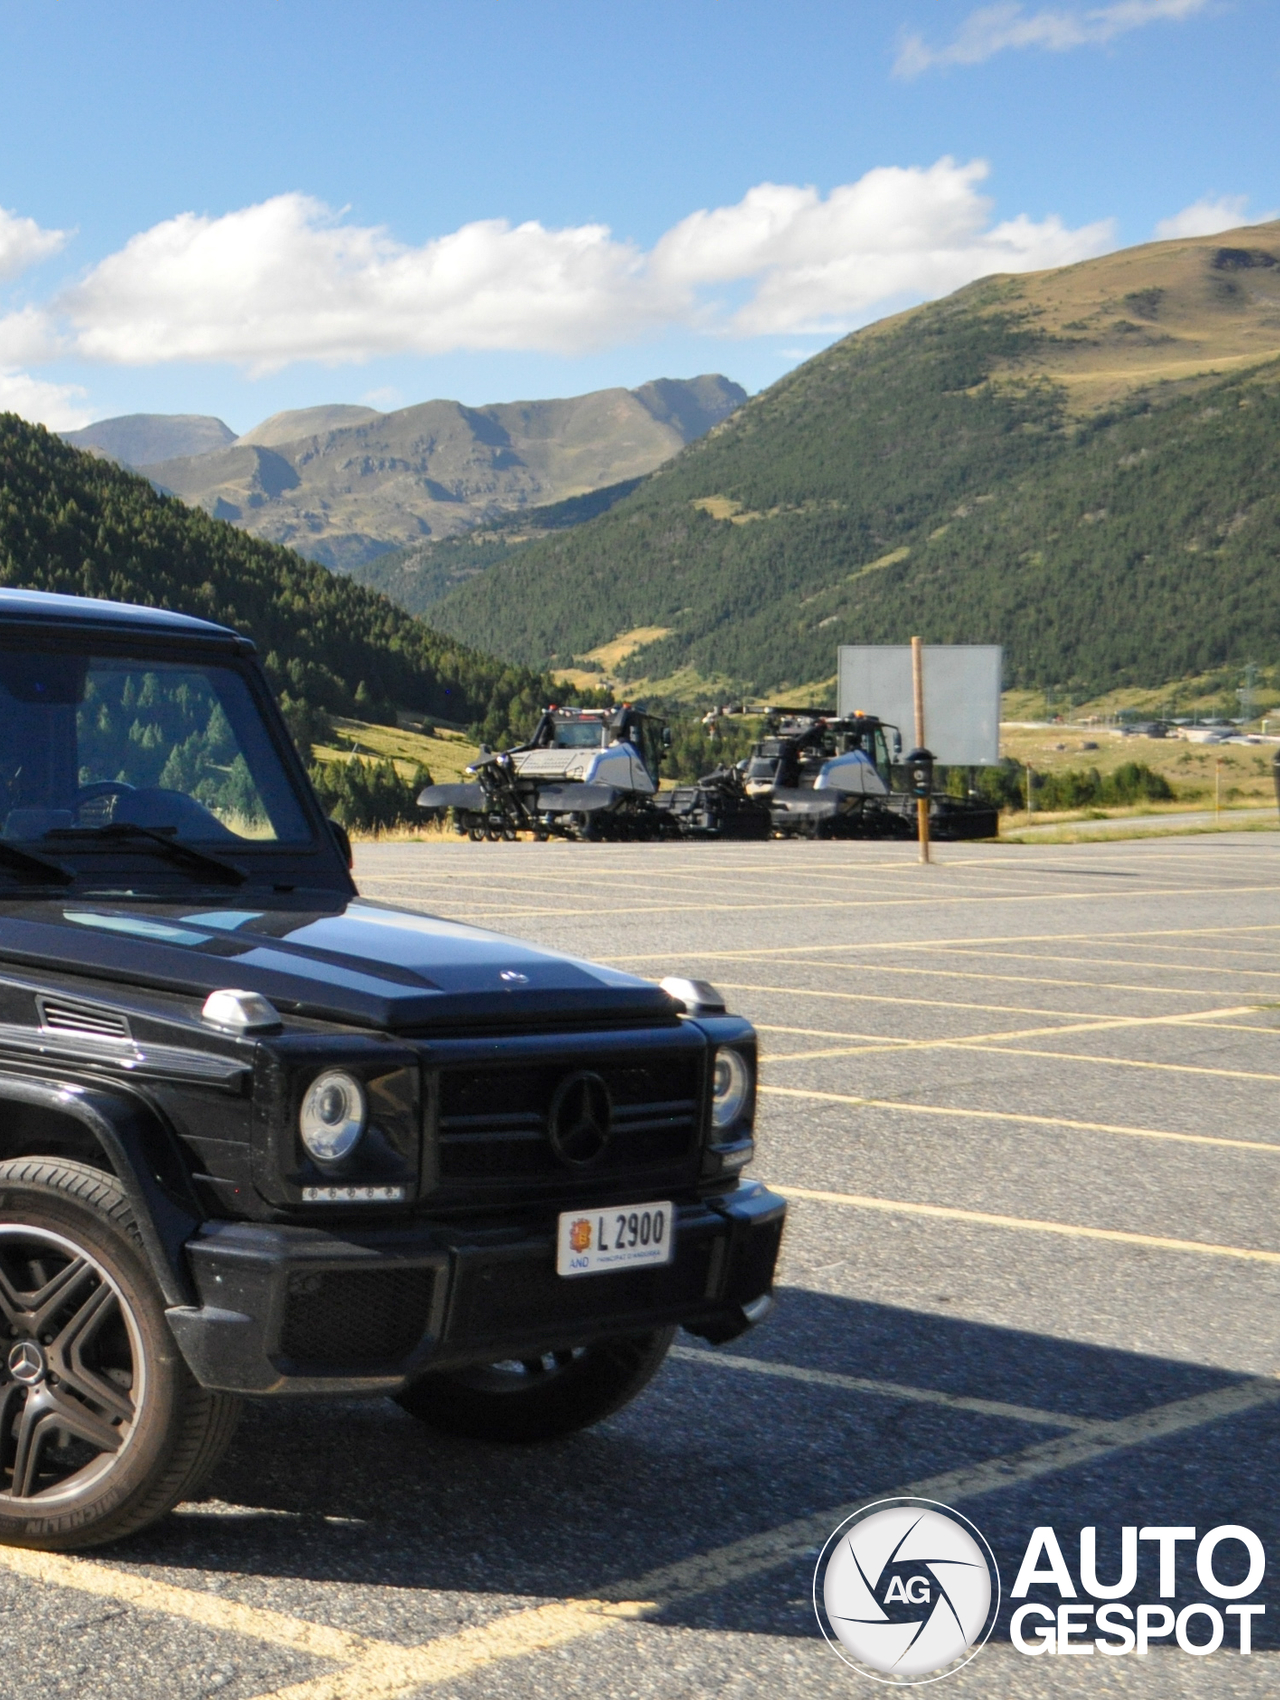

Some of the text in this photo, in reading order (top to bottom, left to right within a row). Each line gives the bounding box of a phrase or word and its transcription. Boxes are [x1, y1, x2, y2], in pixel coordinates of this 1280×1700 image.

[598, 1210, 664, 1250] L 2900
[569, 1256, 589, 1269] AND
[25, 1490, 120, 1534] MICHELIN
